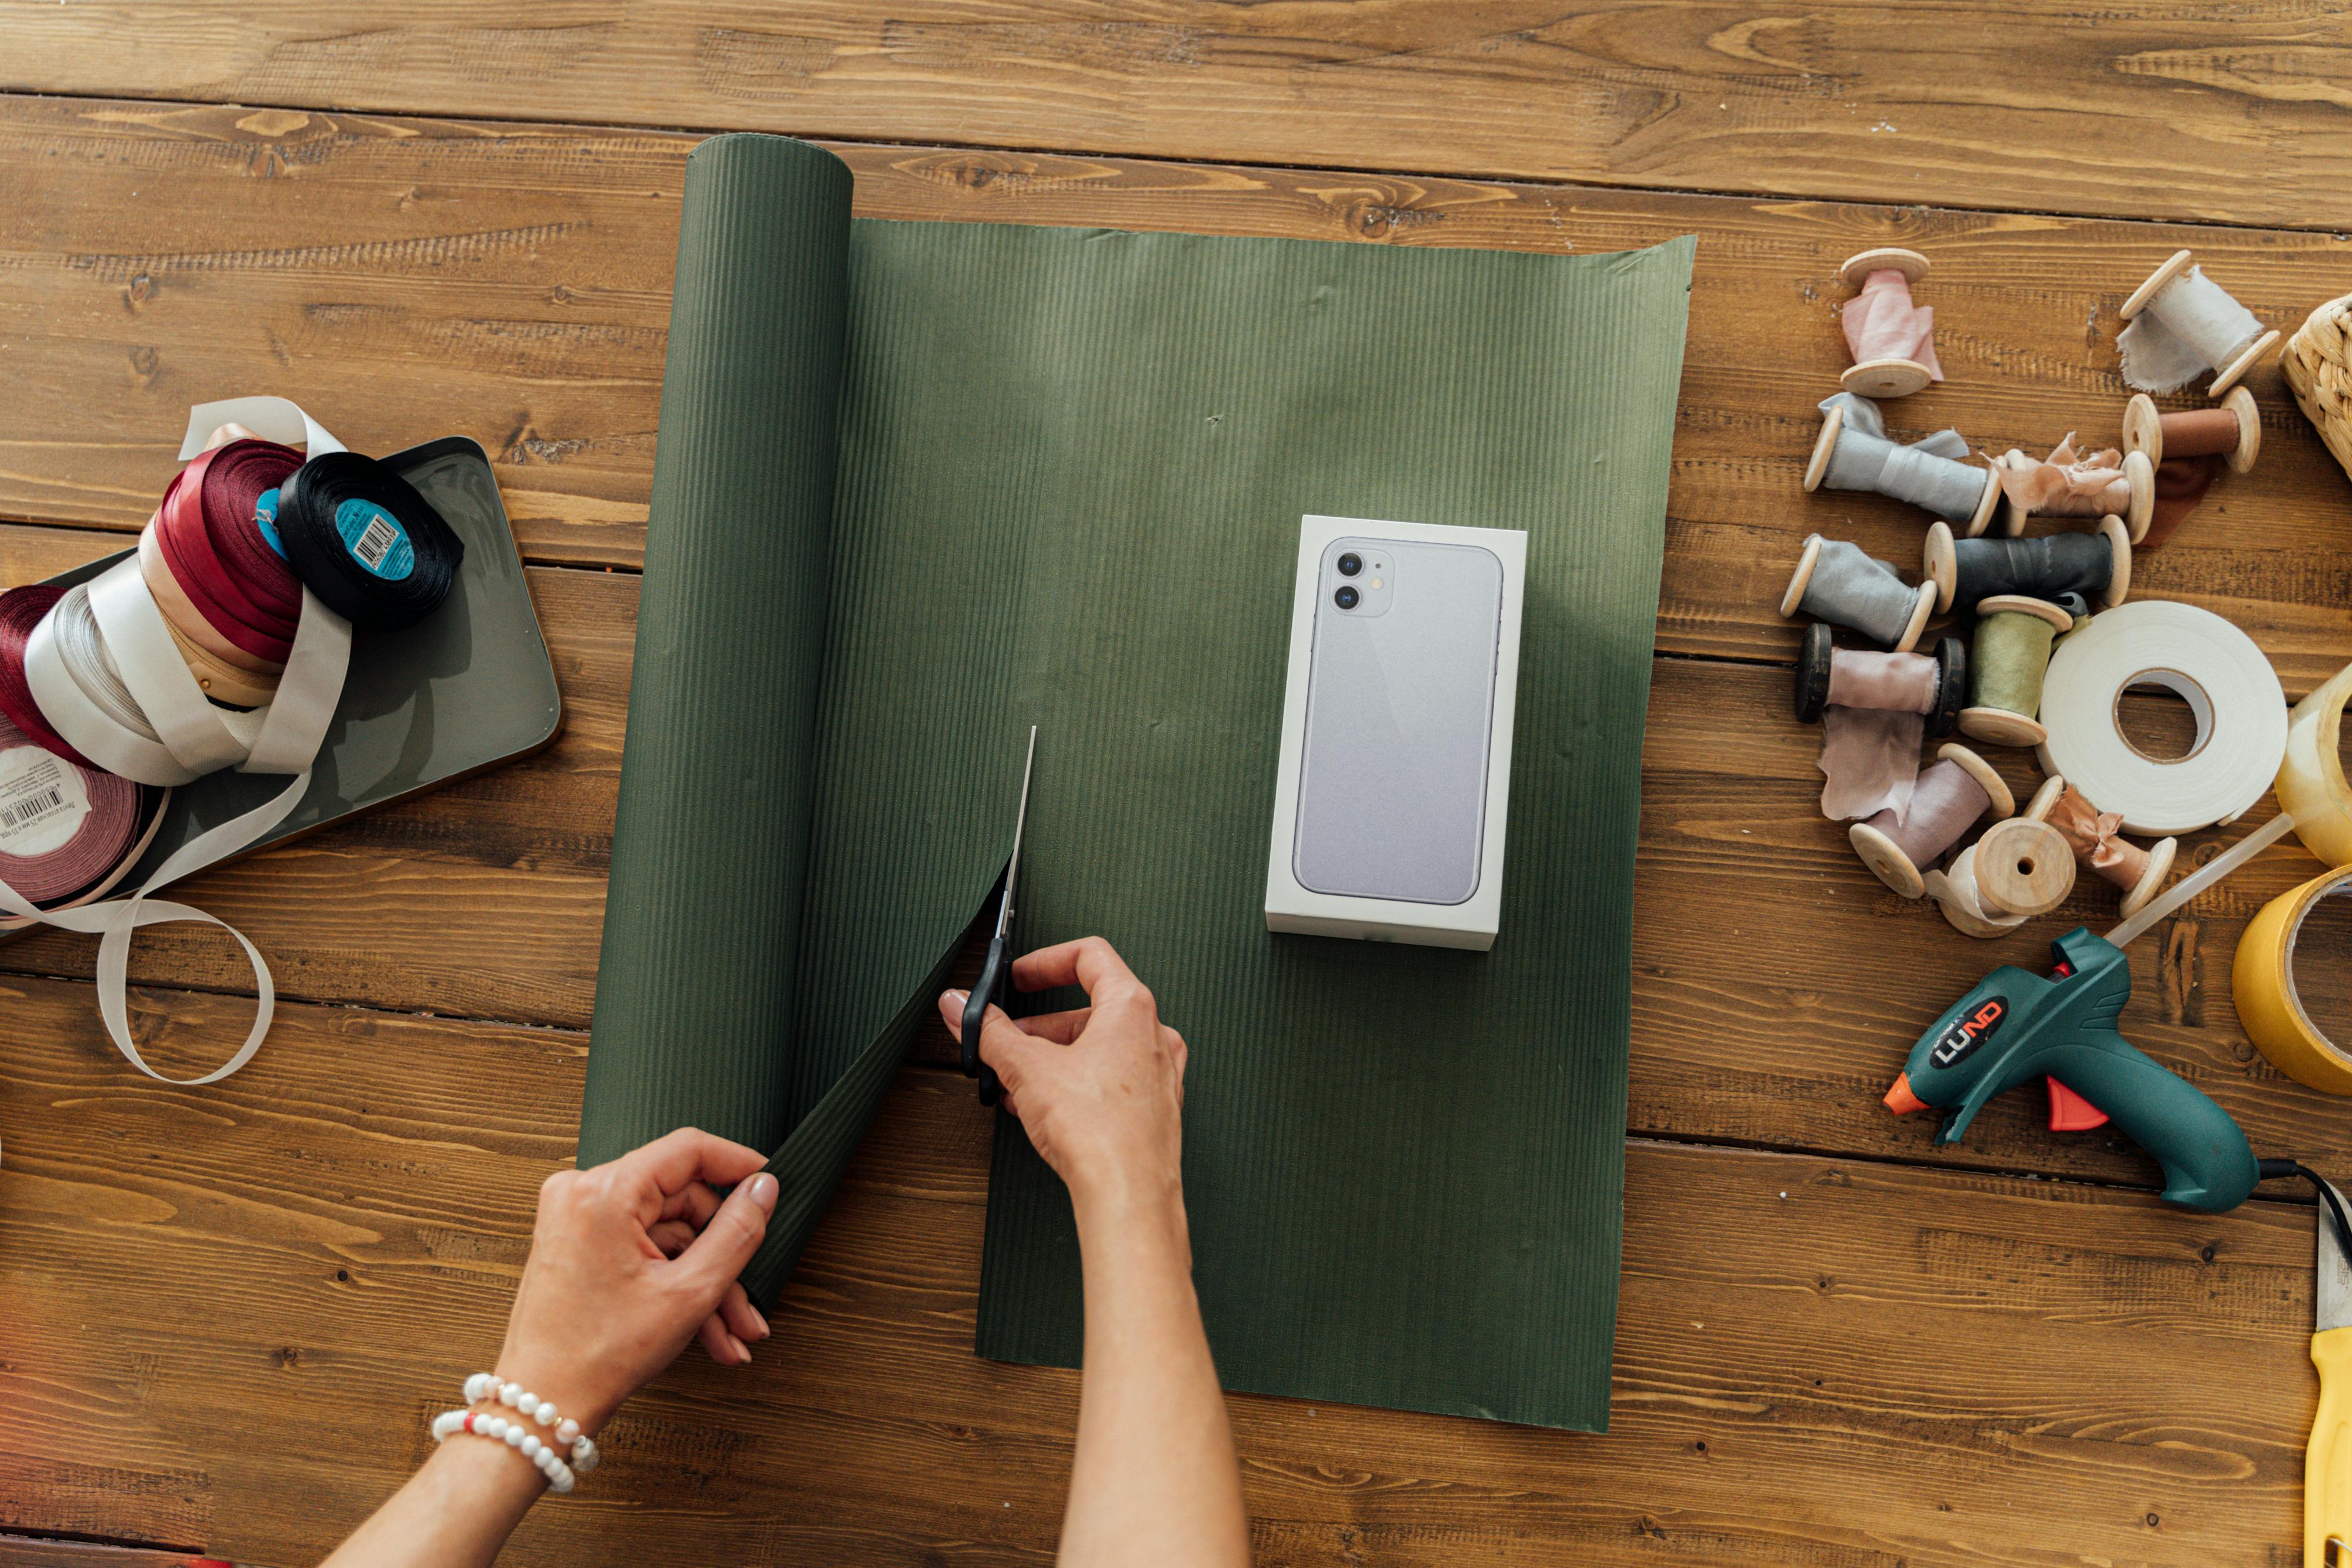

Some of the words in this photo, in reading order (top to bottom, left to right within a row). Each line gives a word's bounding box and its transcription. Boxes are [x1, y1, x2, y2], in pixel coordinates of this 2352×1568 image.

[60, 801, 75, 813] Лента
[38, 808, 60, 823] атласная
[31, 818, 38, 827] 25
[1935, 1001, 2003, 1064] LUND
